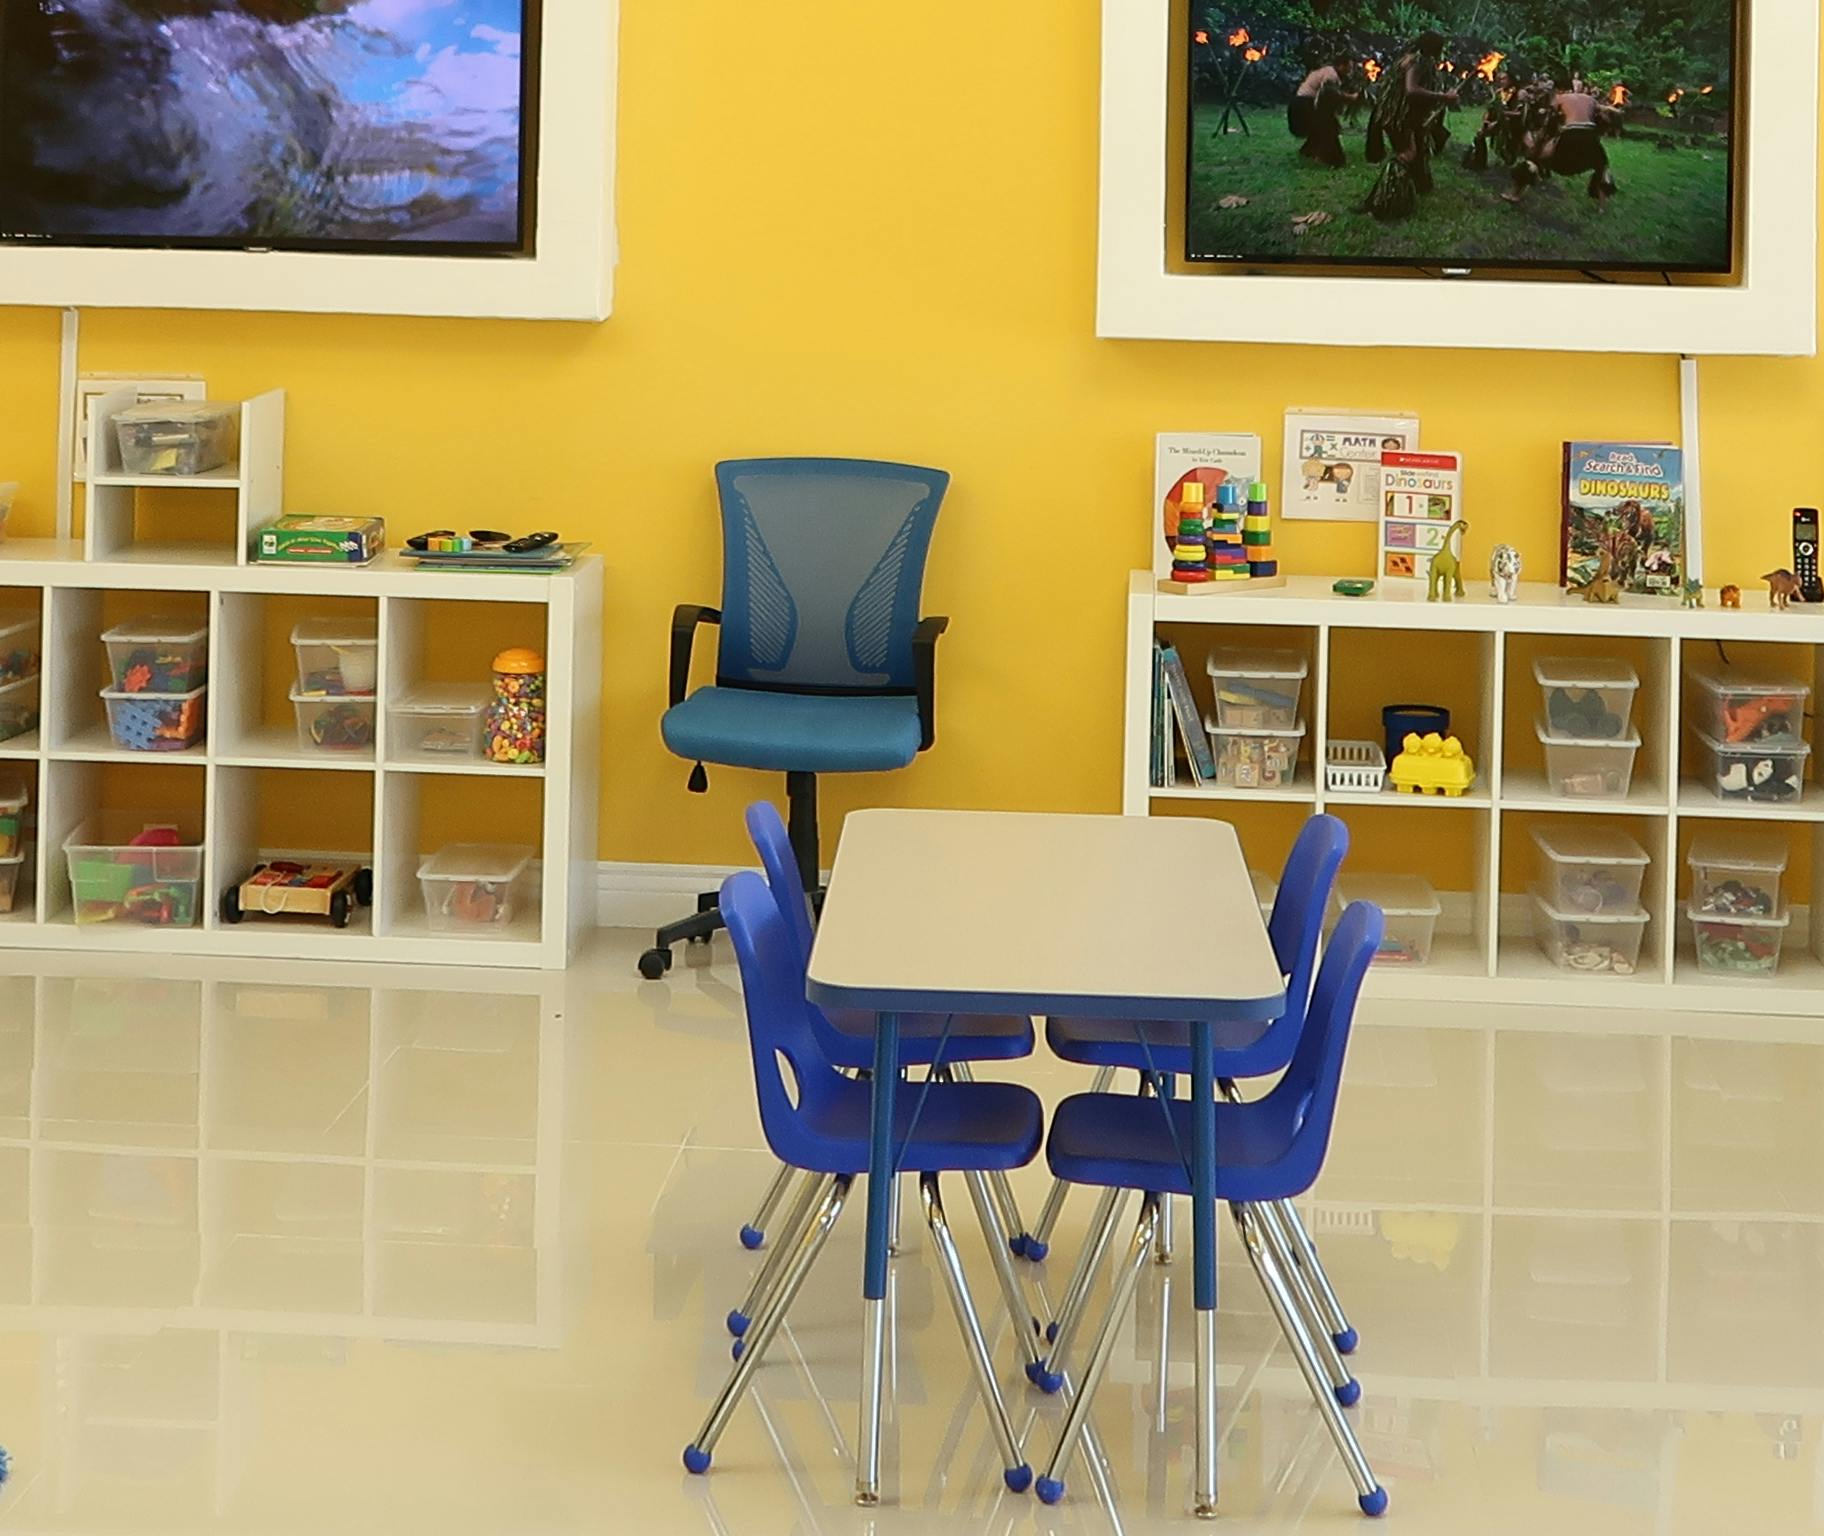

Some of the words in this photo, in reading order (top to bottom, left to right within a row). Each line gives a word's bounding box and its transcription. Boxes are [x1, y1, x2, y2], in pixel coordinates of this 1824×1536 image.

[1168, 446, 1180, 454] The
[1342, 437, 1377, 447] MATH
[1586, 459, 1624, 471] Search
[1635, 465, 1662, 475] Find
[1386, 474, 1453, 490] Dinosaurs
[1580, 479, 1670, 500] DINOSAURS
